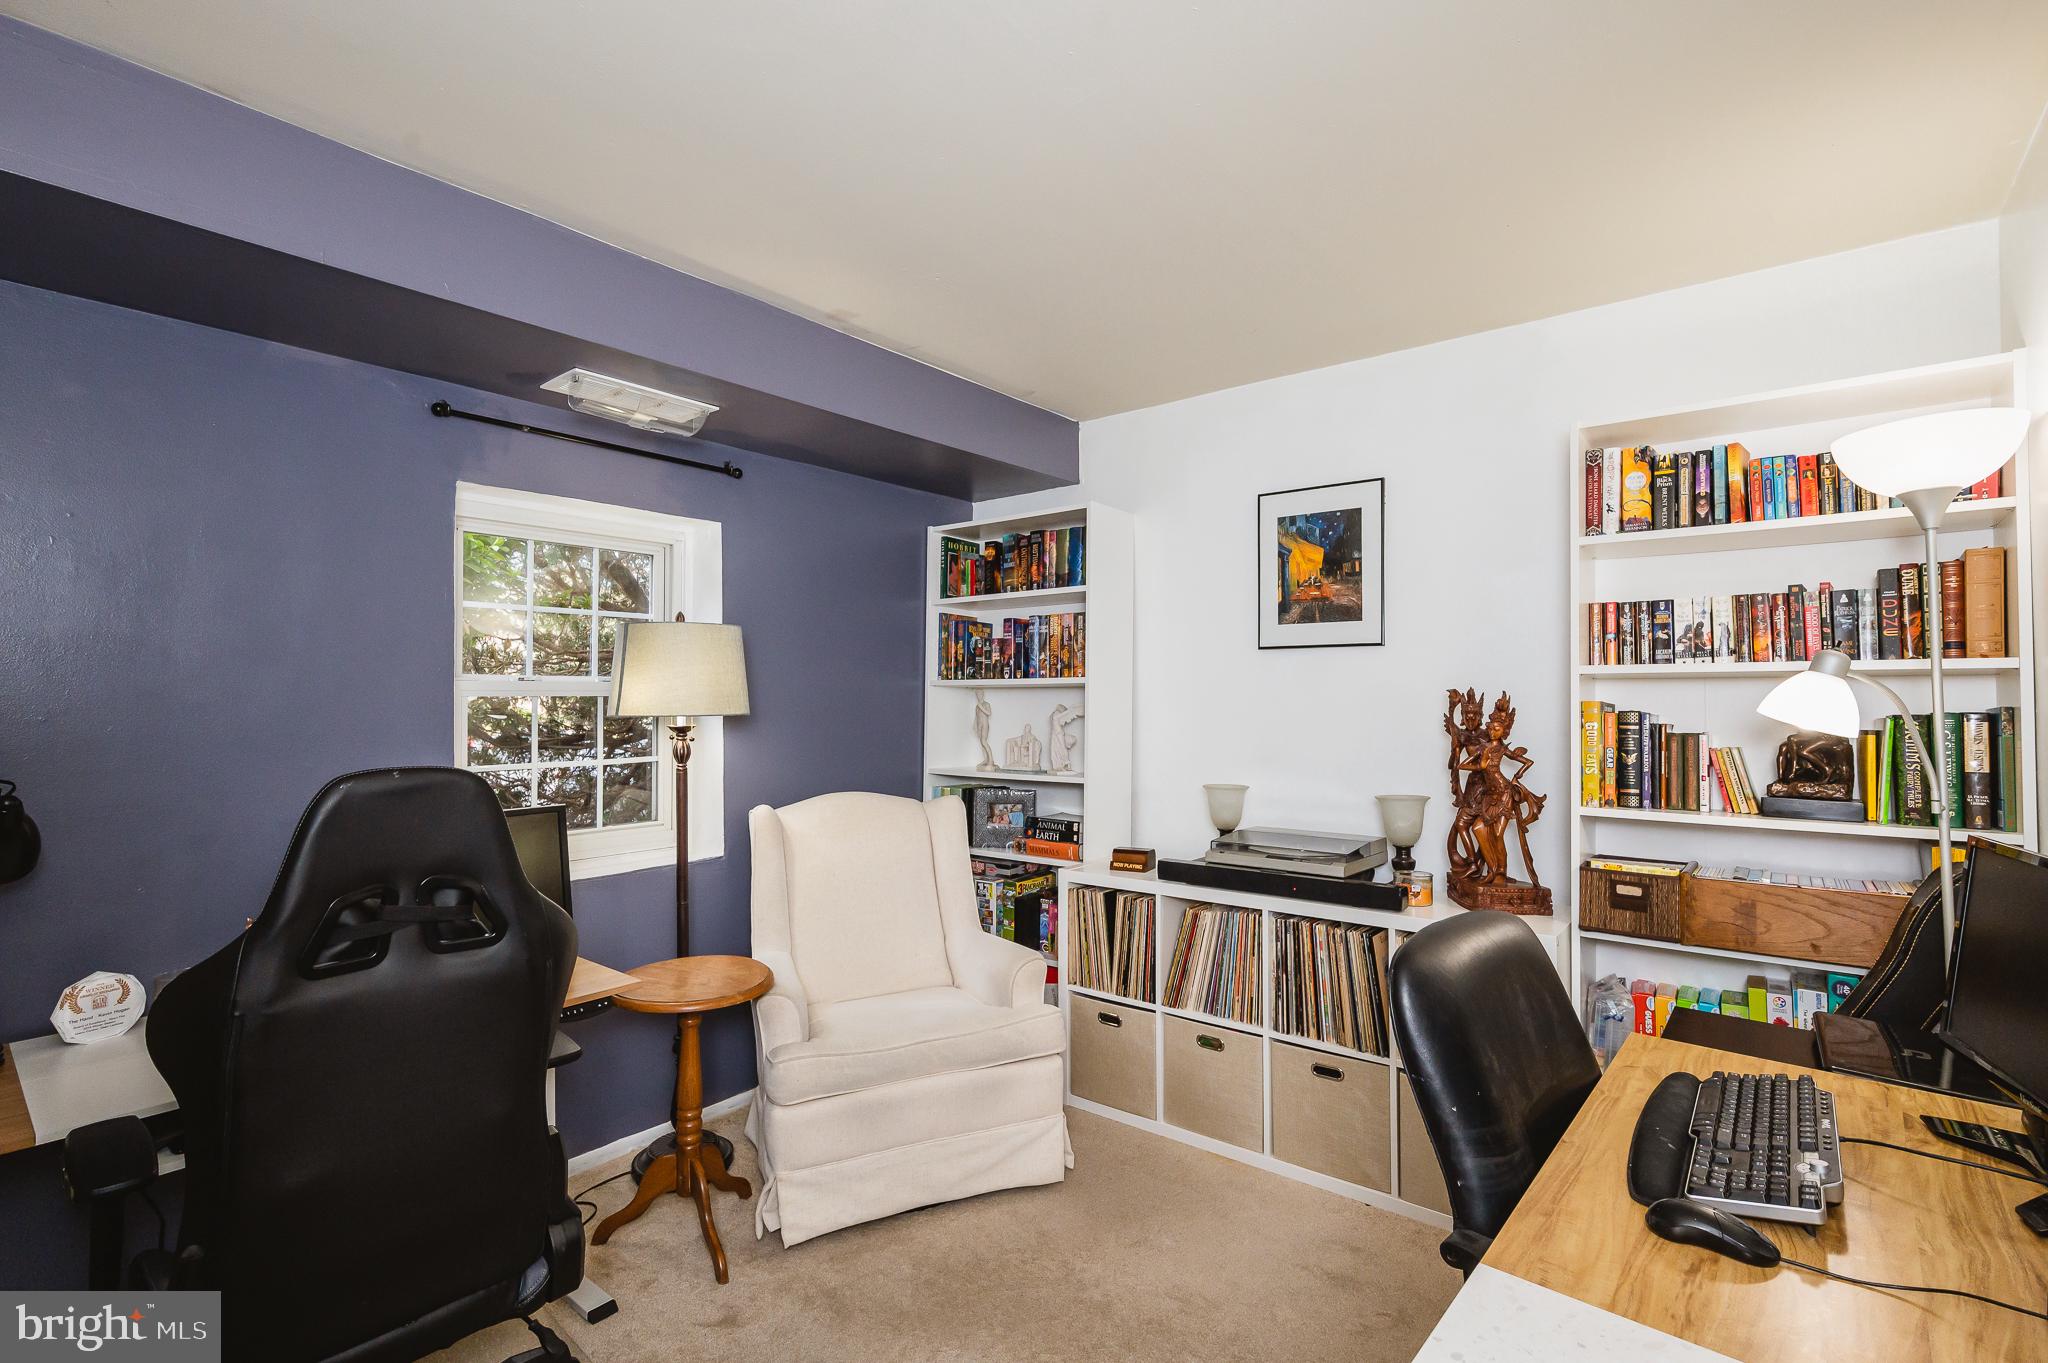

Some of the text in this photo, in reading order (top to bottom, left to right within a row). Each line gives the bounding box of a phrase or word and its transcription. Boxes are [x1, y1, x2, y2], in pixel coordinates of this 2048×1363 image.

[948, 541, 977, 554] HOBBIT
[1902, 569, 1914, 595] DUNE
[1882, 599, 1898, 636] DUNE
[1585, 722, 1598, 774] GOOD EATS
[1606, 748, 1614, 768] GEAR
[1914, 771, 1922, 808] COMPLETE
[1036, 830, 1059, 841] EARTH
[1037, 821, 1066, 831] ANIMAL
[1029, 845, 1060, 856] MAMMALS
[86, 984, 115, 993] WINNER
[1644, 1010, 1653, 1034] GUESS
